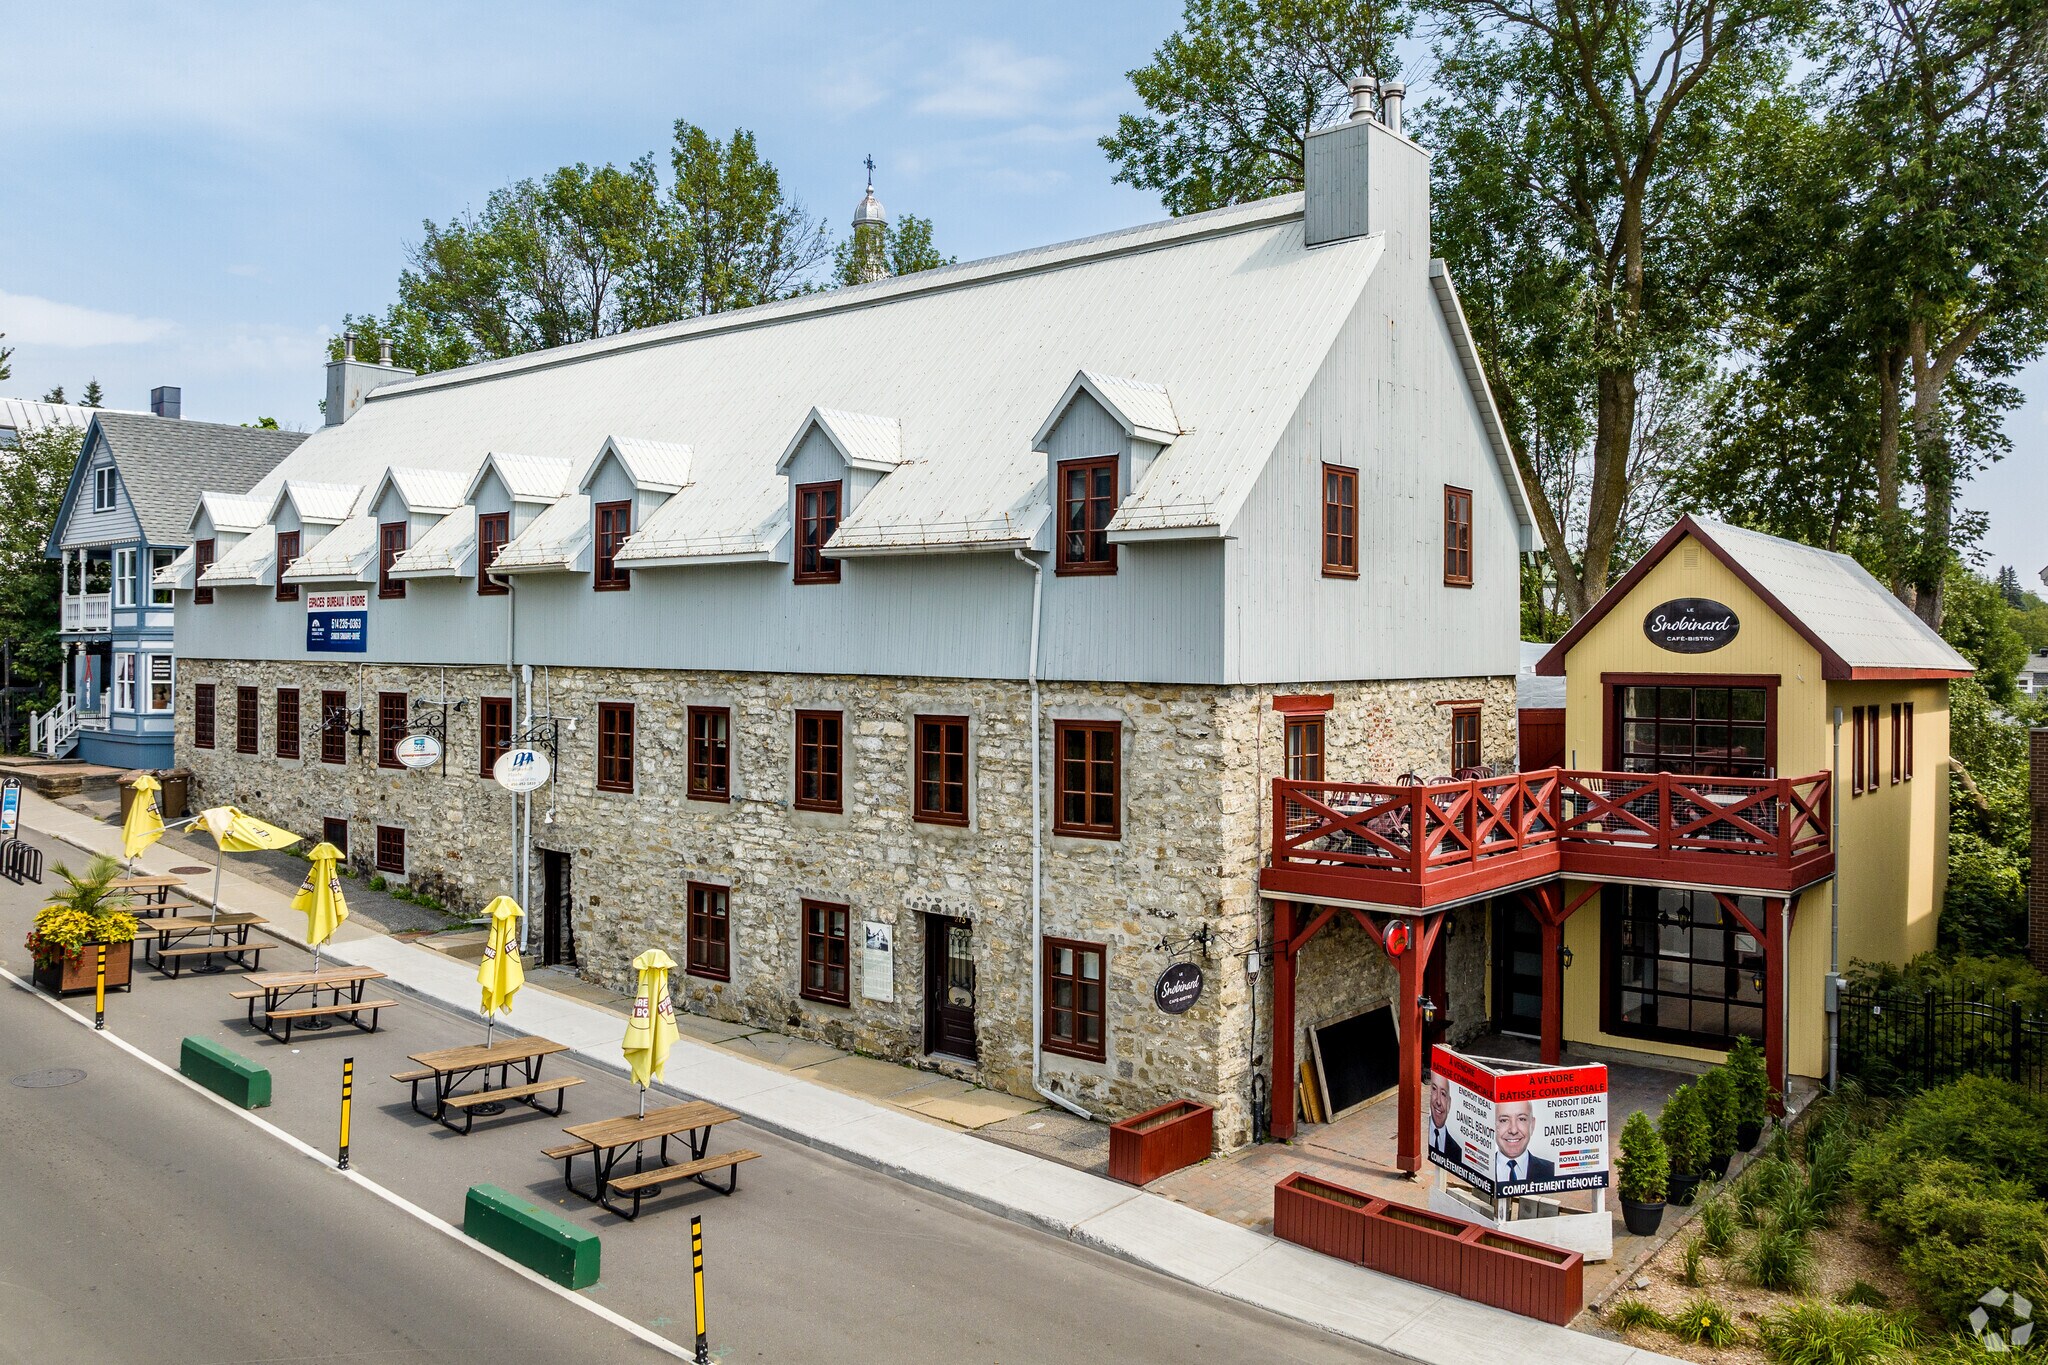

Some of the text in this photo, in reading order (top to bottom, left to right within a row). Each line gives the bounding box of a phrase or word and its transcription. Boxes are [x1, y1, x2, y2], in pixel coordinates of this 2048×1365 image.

[309, 597, 325, 608] ESPACES
[327, 596, 344, 607] BUREAUX
[350, 595, 365, 607] VENDRE
[1651, 614, 1731, 632] Snobinard
[1161, 974, 1200, 999] Snobinard
[1454, 1060, 1475, 1077] VENDRE
[1453, 1073, 1494, 1100] COMMERCIALE
[1529, 1073, 1574, 1085] À VENDRE
[1458, 1086, 1492, 1111] ENDROIT IDÉAL
[1500, 1083, 1605, 1101] BÂTISSE COMMERCIALE
[1462, 1100, 1487, 1119] RESTO/BAR
[1547, 1095, 1602, 1108] ENDROIT IDÉAL
[1456, 1110, 1475, 1130] DANIEL
[1554, 1107, 1595, 1119] RESTO/BAR
[1460, 1125, 1492, 1150] 450-918-9001
[1544, 1123, 1575, 1137] DANIEL
[1550, 1133, 1603, 1147] 450-918-9001
[1467, 1171, 1491, 1193] RÉNOVÉE
[1566, 1174, 1603, 1189] RÉNOVÉE
